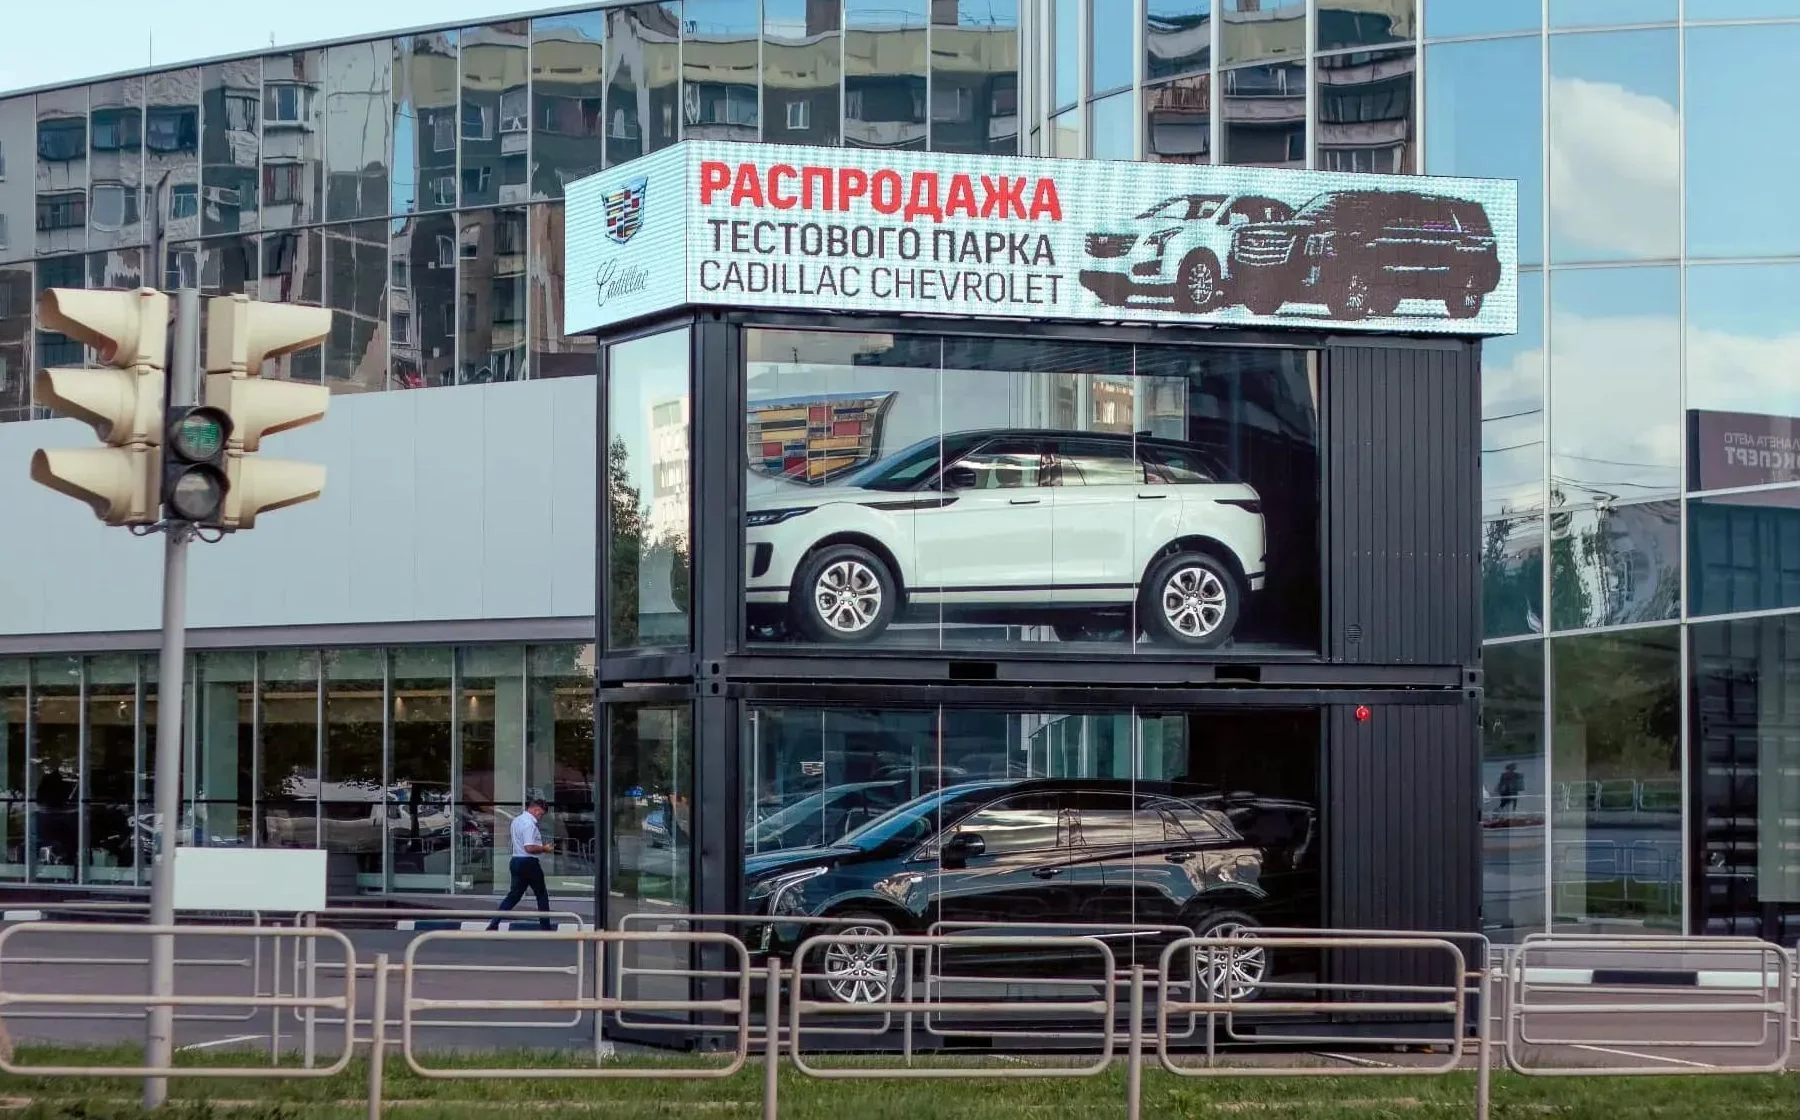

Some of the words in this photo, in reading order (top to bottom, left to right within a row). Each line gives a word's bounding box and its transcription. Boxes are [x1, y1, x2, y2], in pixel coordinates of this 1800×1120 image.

[700, 161, 1063, 222] РАСПРОДАЖА
[707, 218, 921, 260] ТЕСТОВОГО
[932, 229, 1056, 266] ПАРКА
[596, 257, 650, 308] Cadillac
[699, 259, 861, 297] CADILLAC
[871, 266, 1063, 305] CHEVROLET
